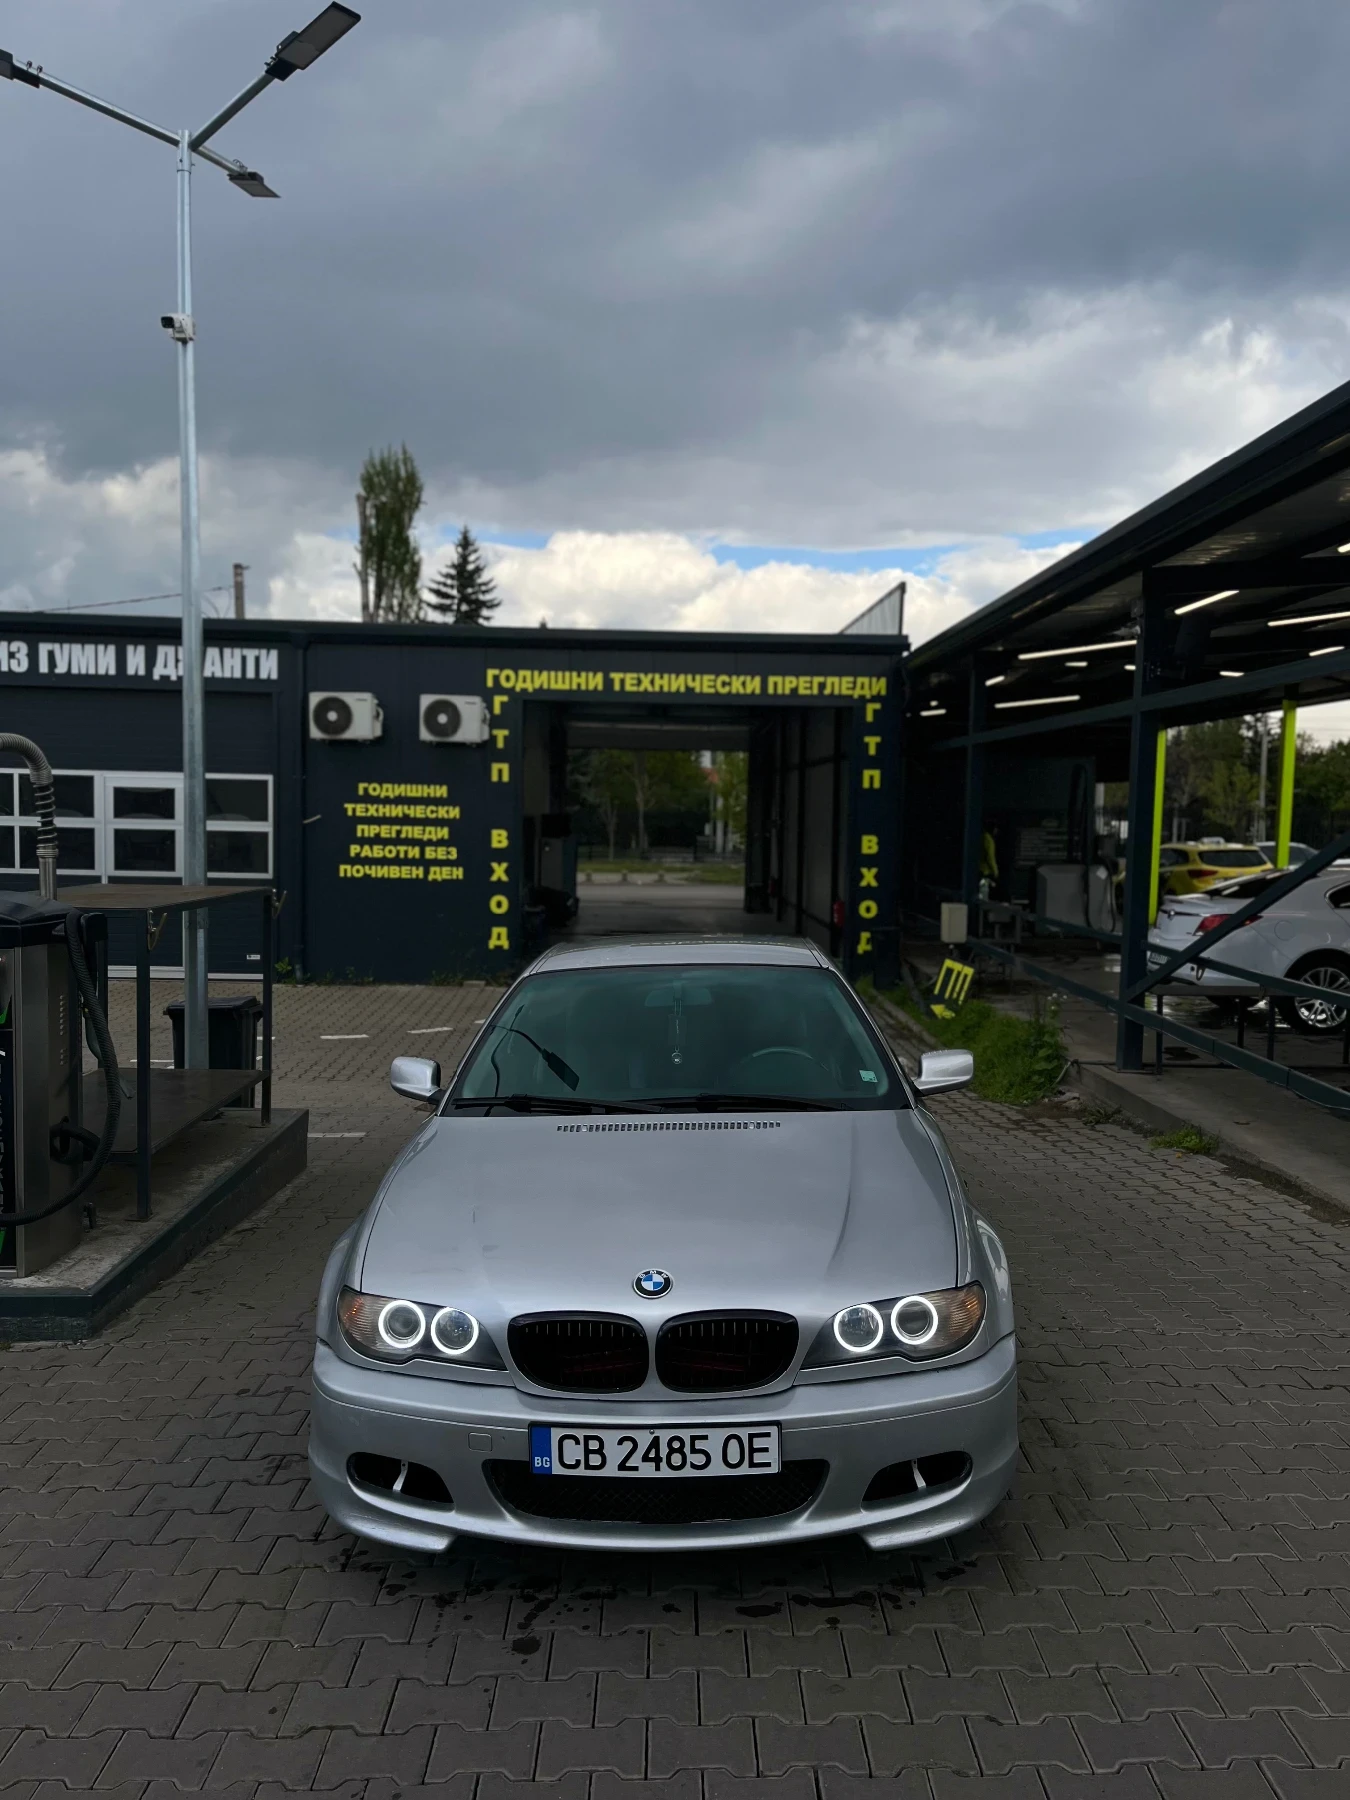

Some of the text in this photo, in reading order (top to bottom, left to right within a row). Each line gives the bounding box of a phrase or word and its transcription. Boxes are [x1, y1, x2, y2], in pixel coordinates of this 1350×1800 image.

[39, 643, 116, 675] ГУМИ
[127, 645, 145, 675] И
[153, 645, 278, 680] ДАНТИ
[487, 669, 886, 697] ГОДИШНИ ТЕХНИЧЕСКИ ПРЕГЛЕДИ
[863, 703, 880, 788] ГТП
[359, 784, 447, 798] ГОДИШНИ
[345, 804, 460, 818] ТЕХНИЧЕСКИ
[489, 696, 509, 949] ГТП ВХОД
[357, 825, 449, 840] ПРЕГЛЕДИ
[350, 845, 457, 859] РАБОТИ БЕЗ
[340, 865, 463, 880] ПОЧИВЕН ДЕН
[557, 1433, 607, 1471] CB
[616, 1434, 712, 1472] 2485
[535, 1456, 551, 1468] BG
